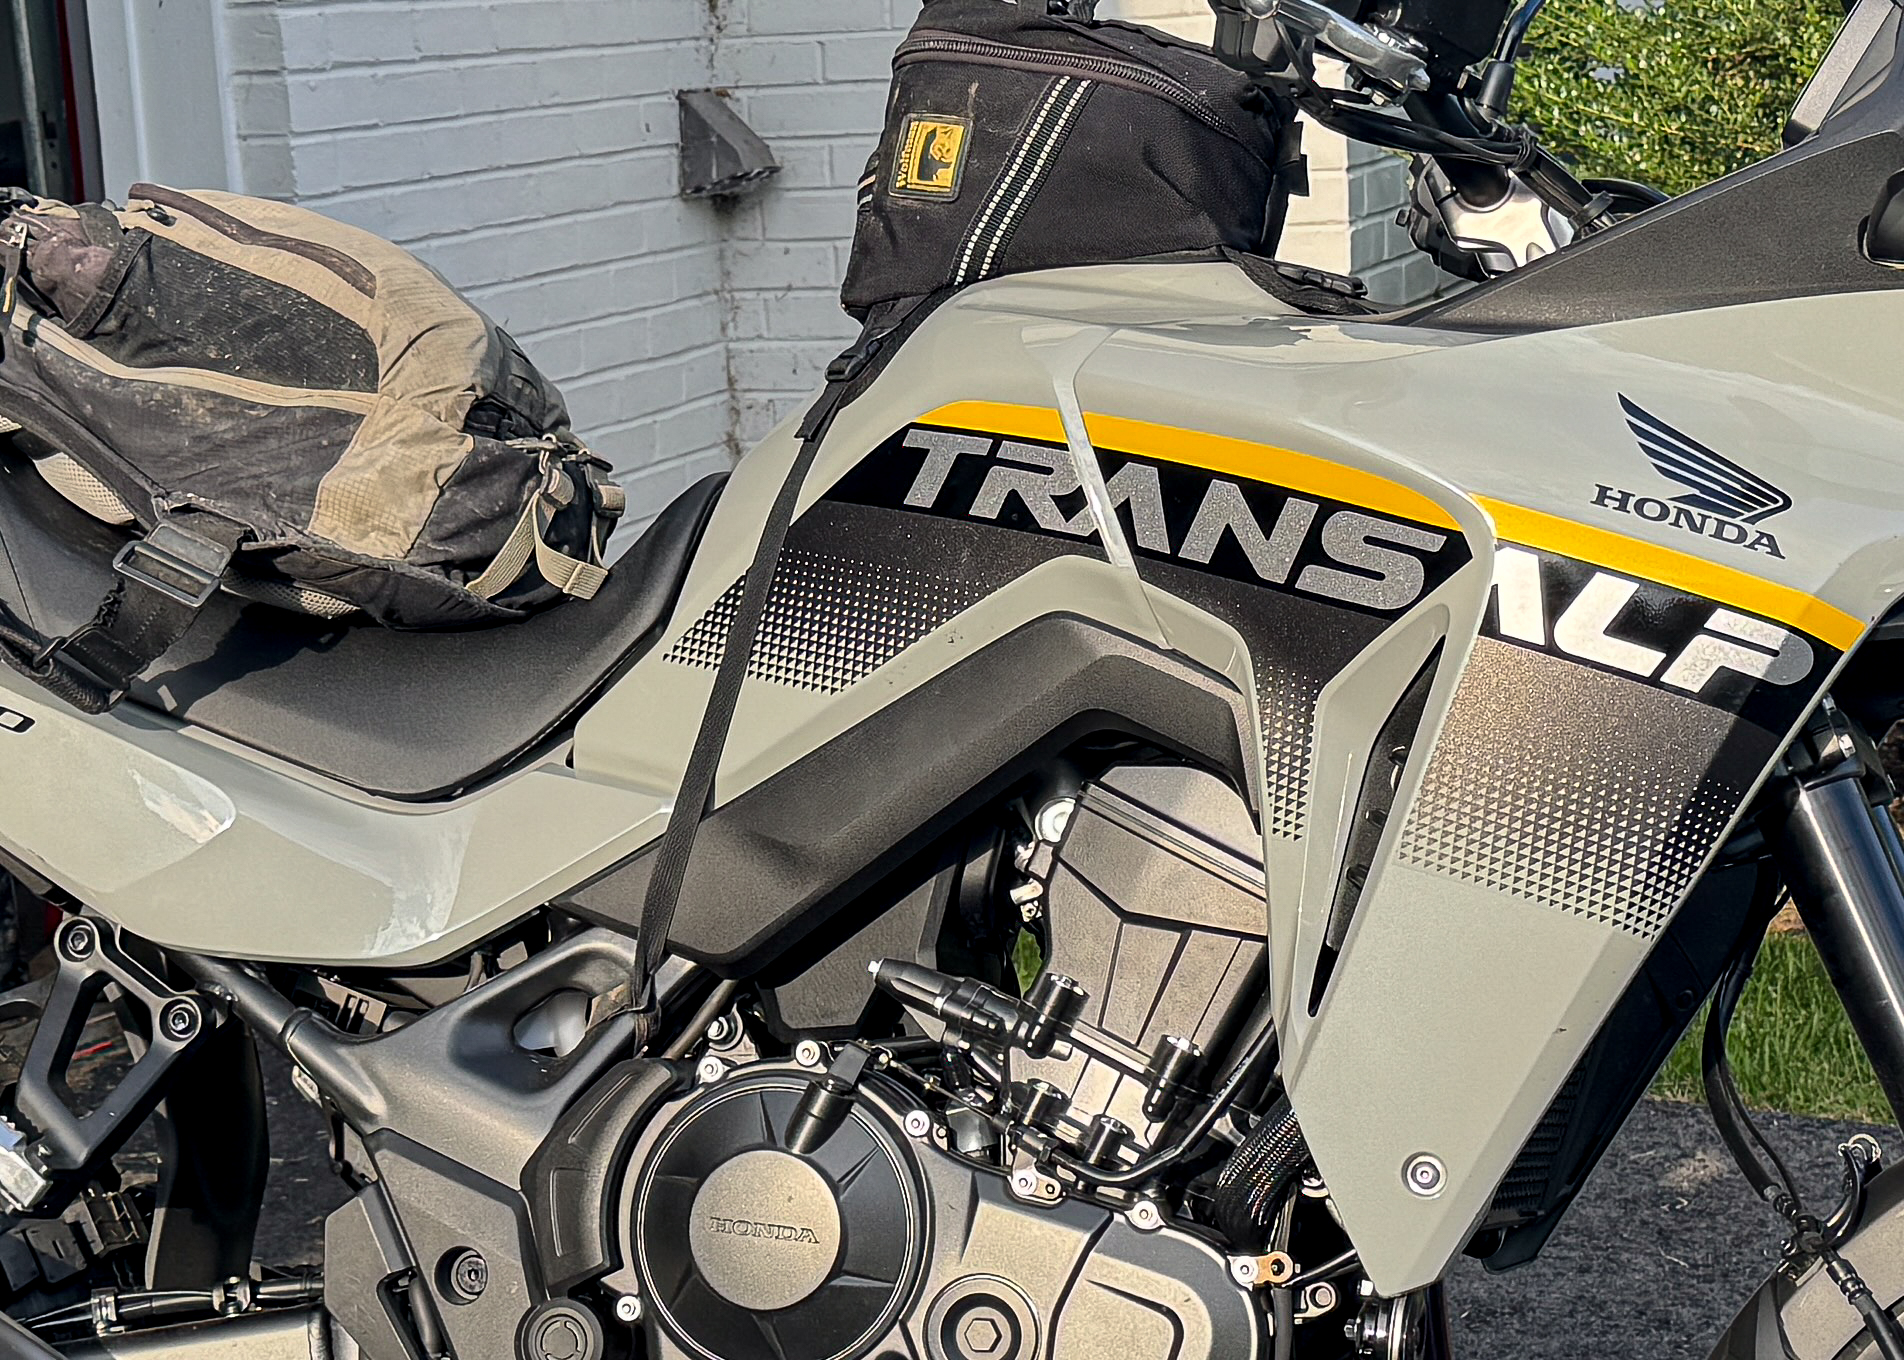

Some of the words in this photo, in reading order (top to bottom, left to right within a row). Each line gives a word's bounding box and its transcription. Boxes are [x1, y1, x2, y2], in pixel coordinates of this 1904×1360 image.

[903, 428, 1447, 612] TRANS
[1590, 483, 1787, 561] HONDA
[709, 1216, 821, 1245] HONDA
